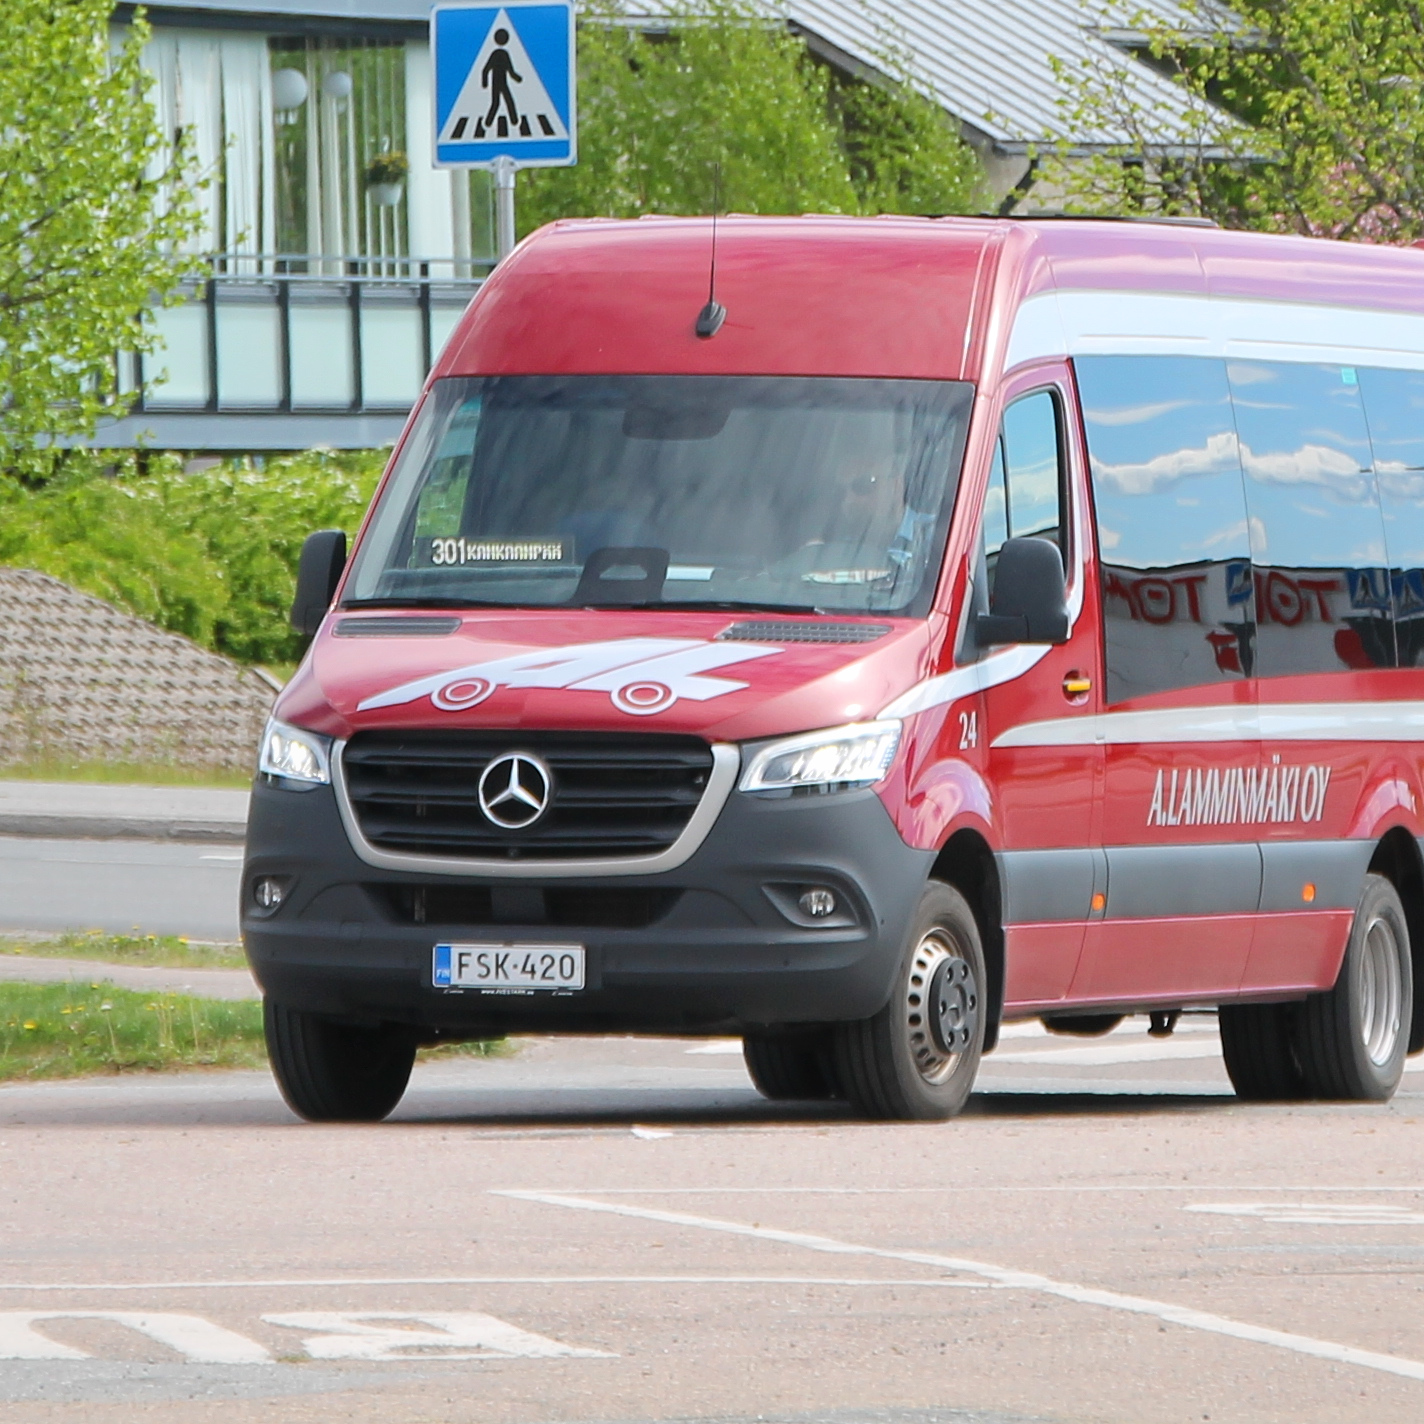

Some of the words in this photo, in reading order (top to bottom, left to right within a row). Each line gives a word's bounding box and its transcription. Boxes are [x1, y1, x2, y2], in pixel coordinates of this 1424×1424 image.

[432, 538, 466, 565] 301
[959, 711, 977, 750] 24
[1301, 765, 1332, 822] OY
[458, 952, 575, 981] FSK-420
